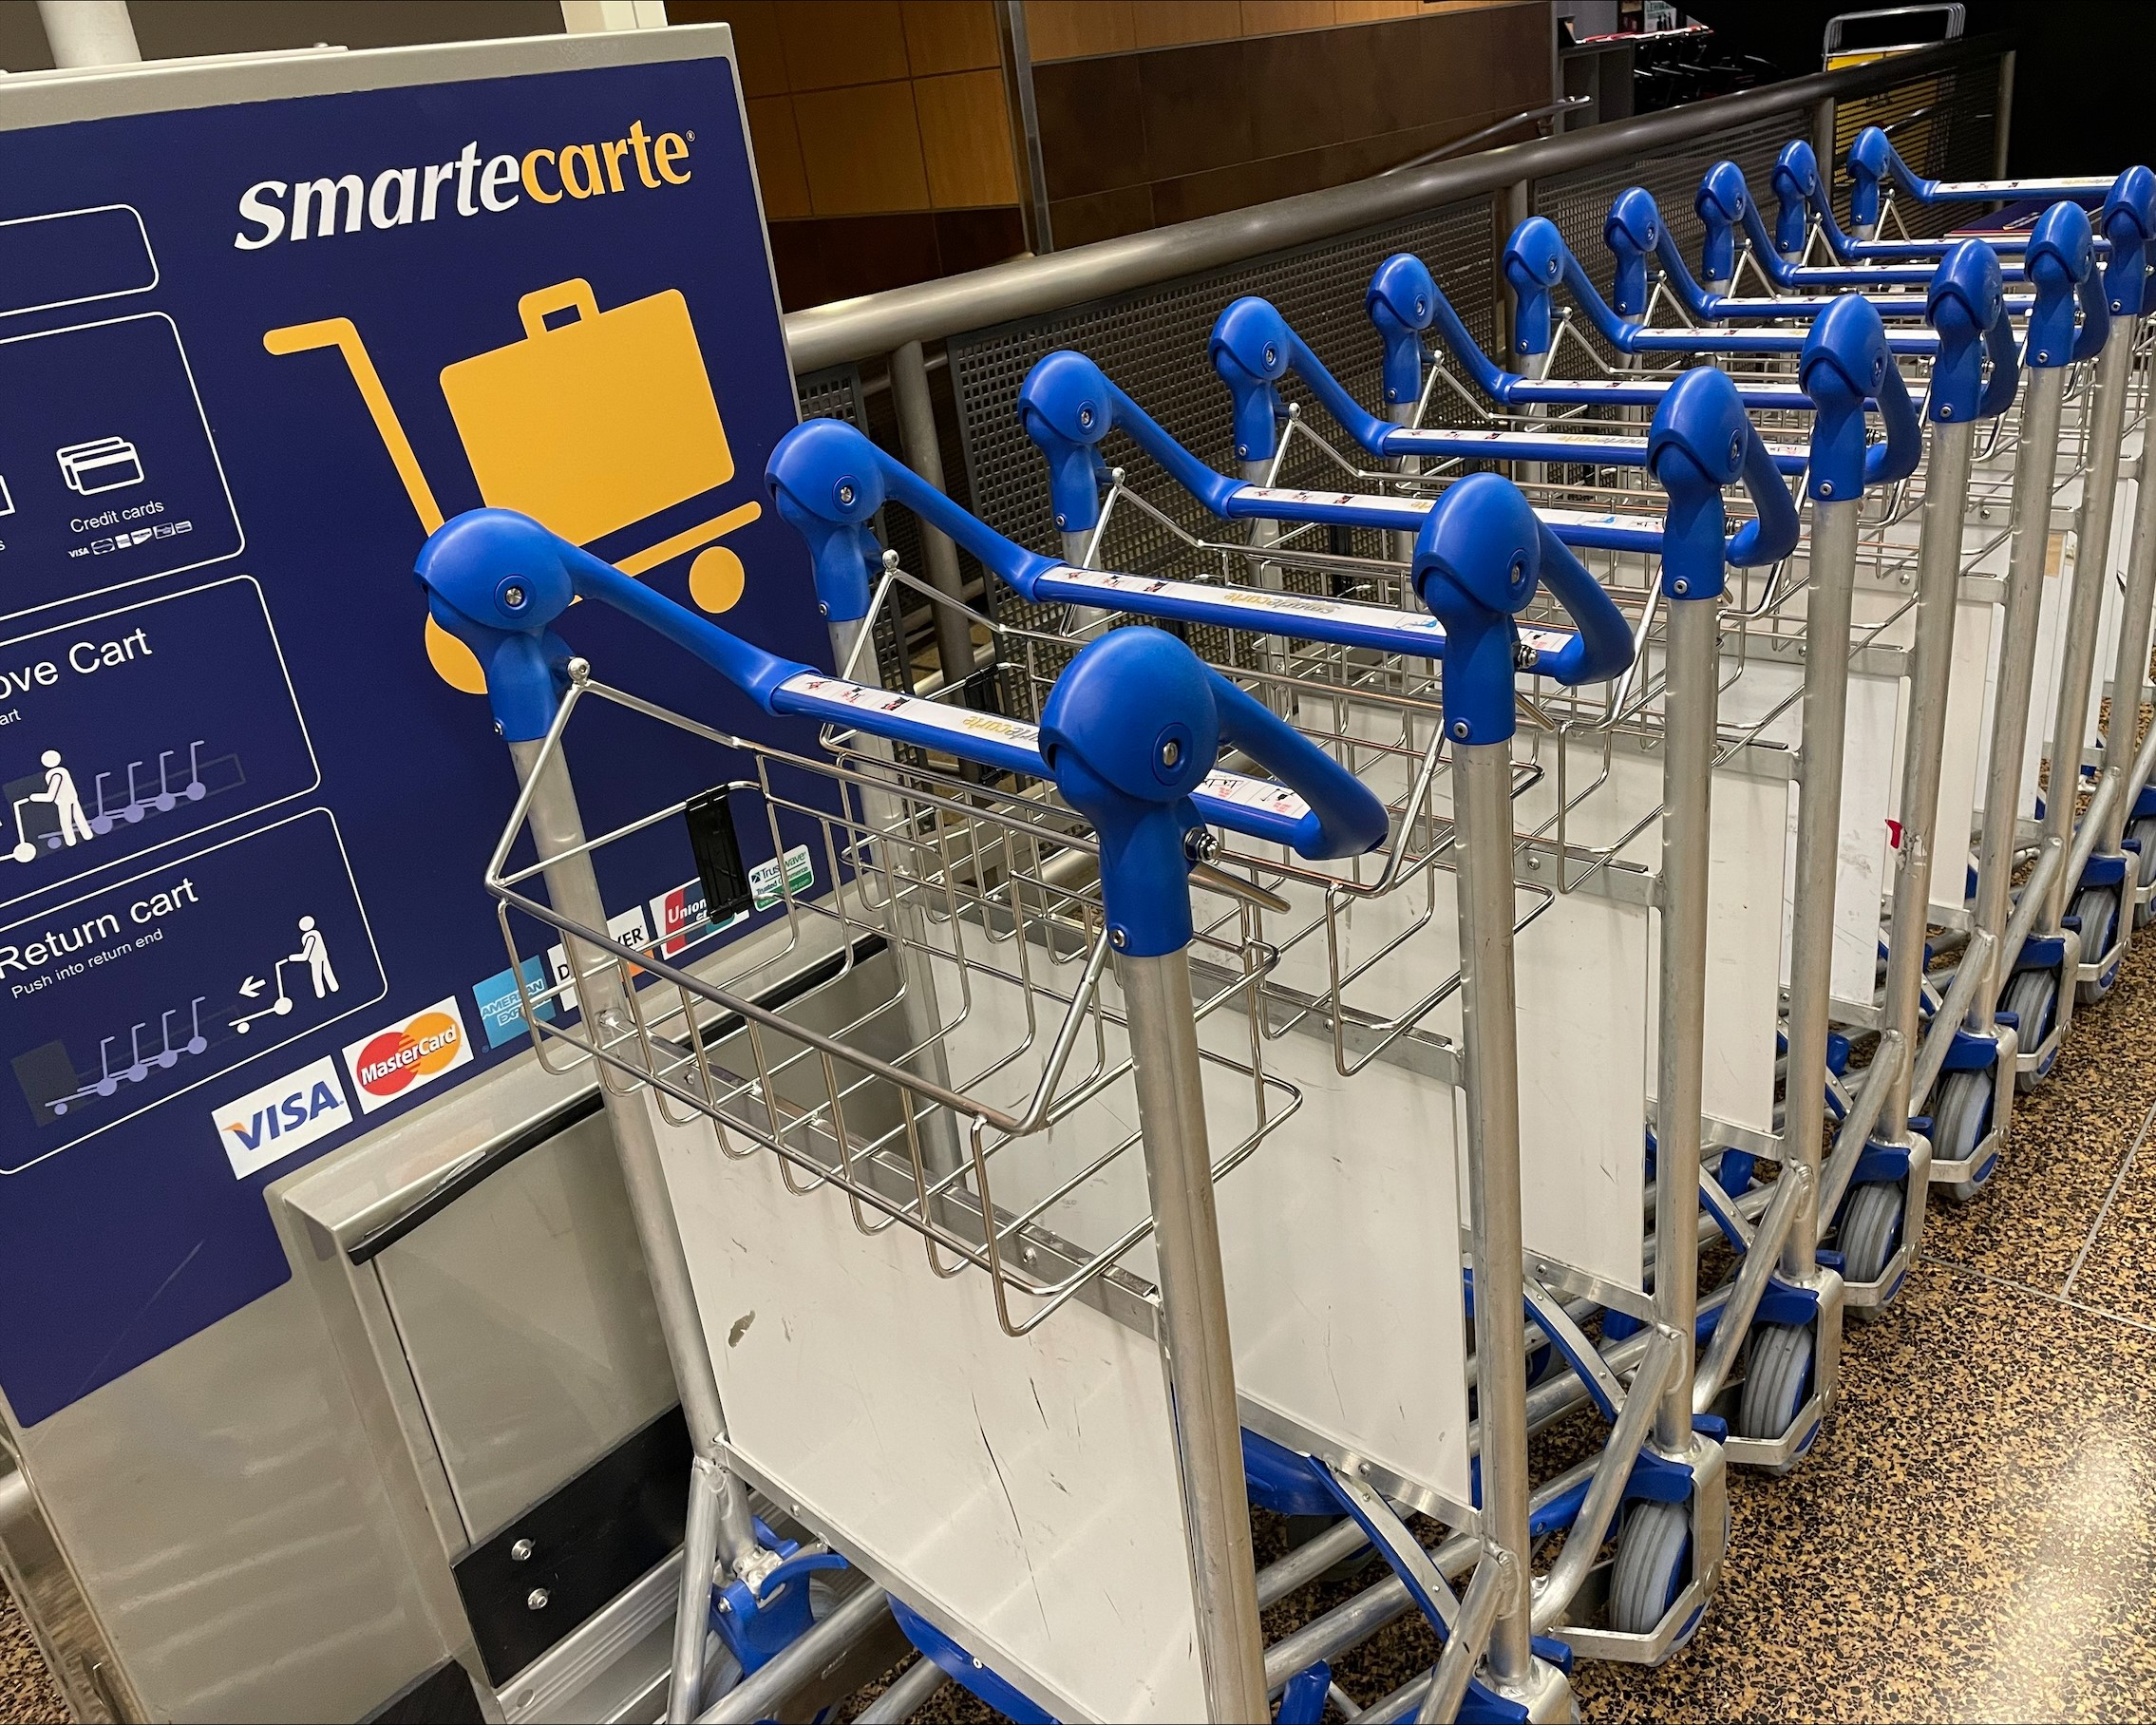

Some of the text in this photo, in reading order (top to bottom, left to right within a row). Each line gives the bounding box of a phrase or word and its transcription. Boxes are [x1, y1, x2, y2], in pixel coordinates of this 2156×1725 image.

[70, 501, 164, 533] Credit cards
[68, 547, 90, 559] VISA
[0, 627, 153, 700] ove Cart
[0, 709, 21, 726] art
[962, 714, 1039, 744] artecarte
[0, 878, 199, 979] Return cart
[668, 899, 708, 924] Union
[11, 928, 164, 998] Push into return end
[481, 979, 544, 1018] AMERAN
[360, 1024, 458, 1086] MasterCard
[221, 1080, 341, 1151] VISA
